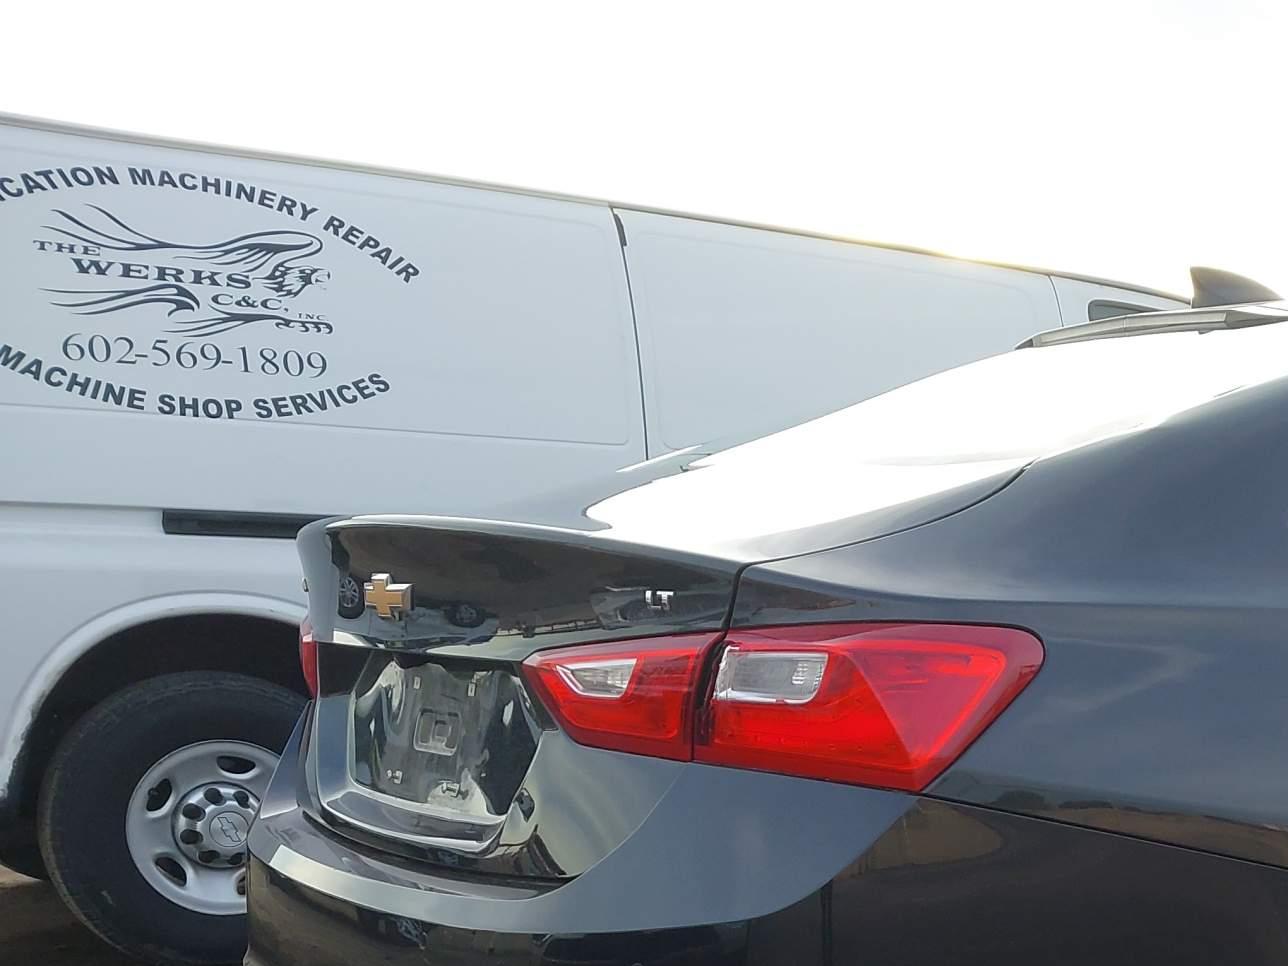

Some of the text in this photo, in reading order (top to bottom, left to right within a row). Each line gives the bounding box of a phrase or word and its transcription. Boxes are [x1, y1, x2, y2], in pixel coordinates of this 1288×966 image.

[0, 166, 421, 284] CATION MACHINERY REPAIR
[32, 239, 101, 257] THE
[70, 257, 252, 290] WERKS
[61, 332, 328, 379] 602-569-1809
[0, 344, 391, 420] MACHINE SHOP SERVICES
[645, 590, 674, 609] LT
